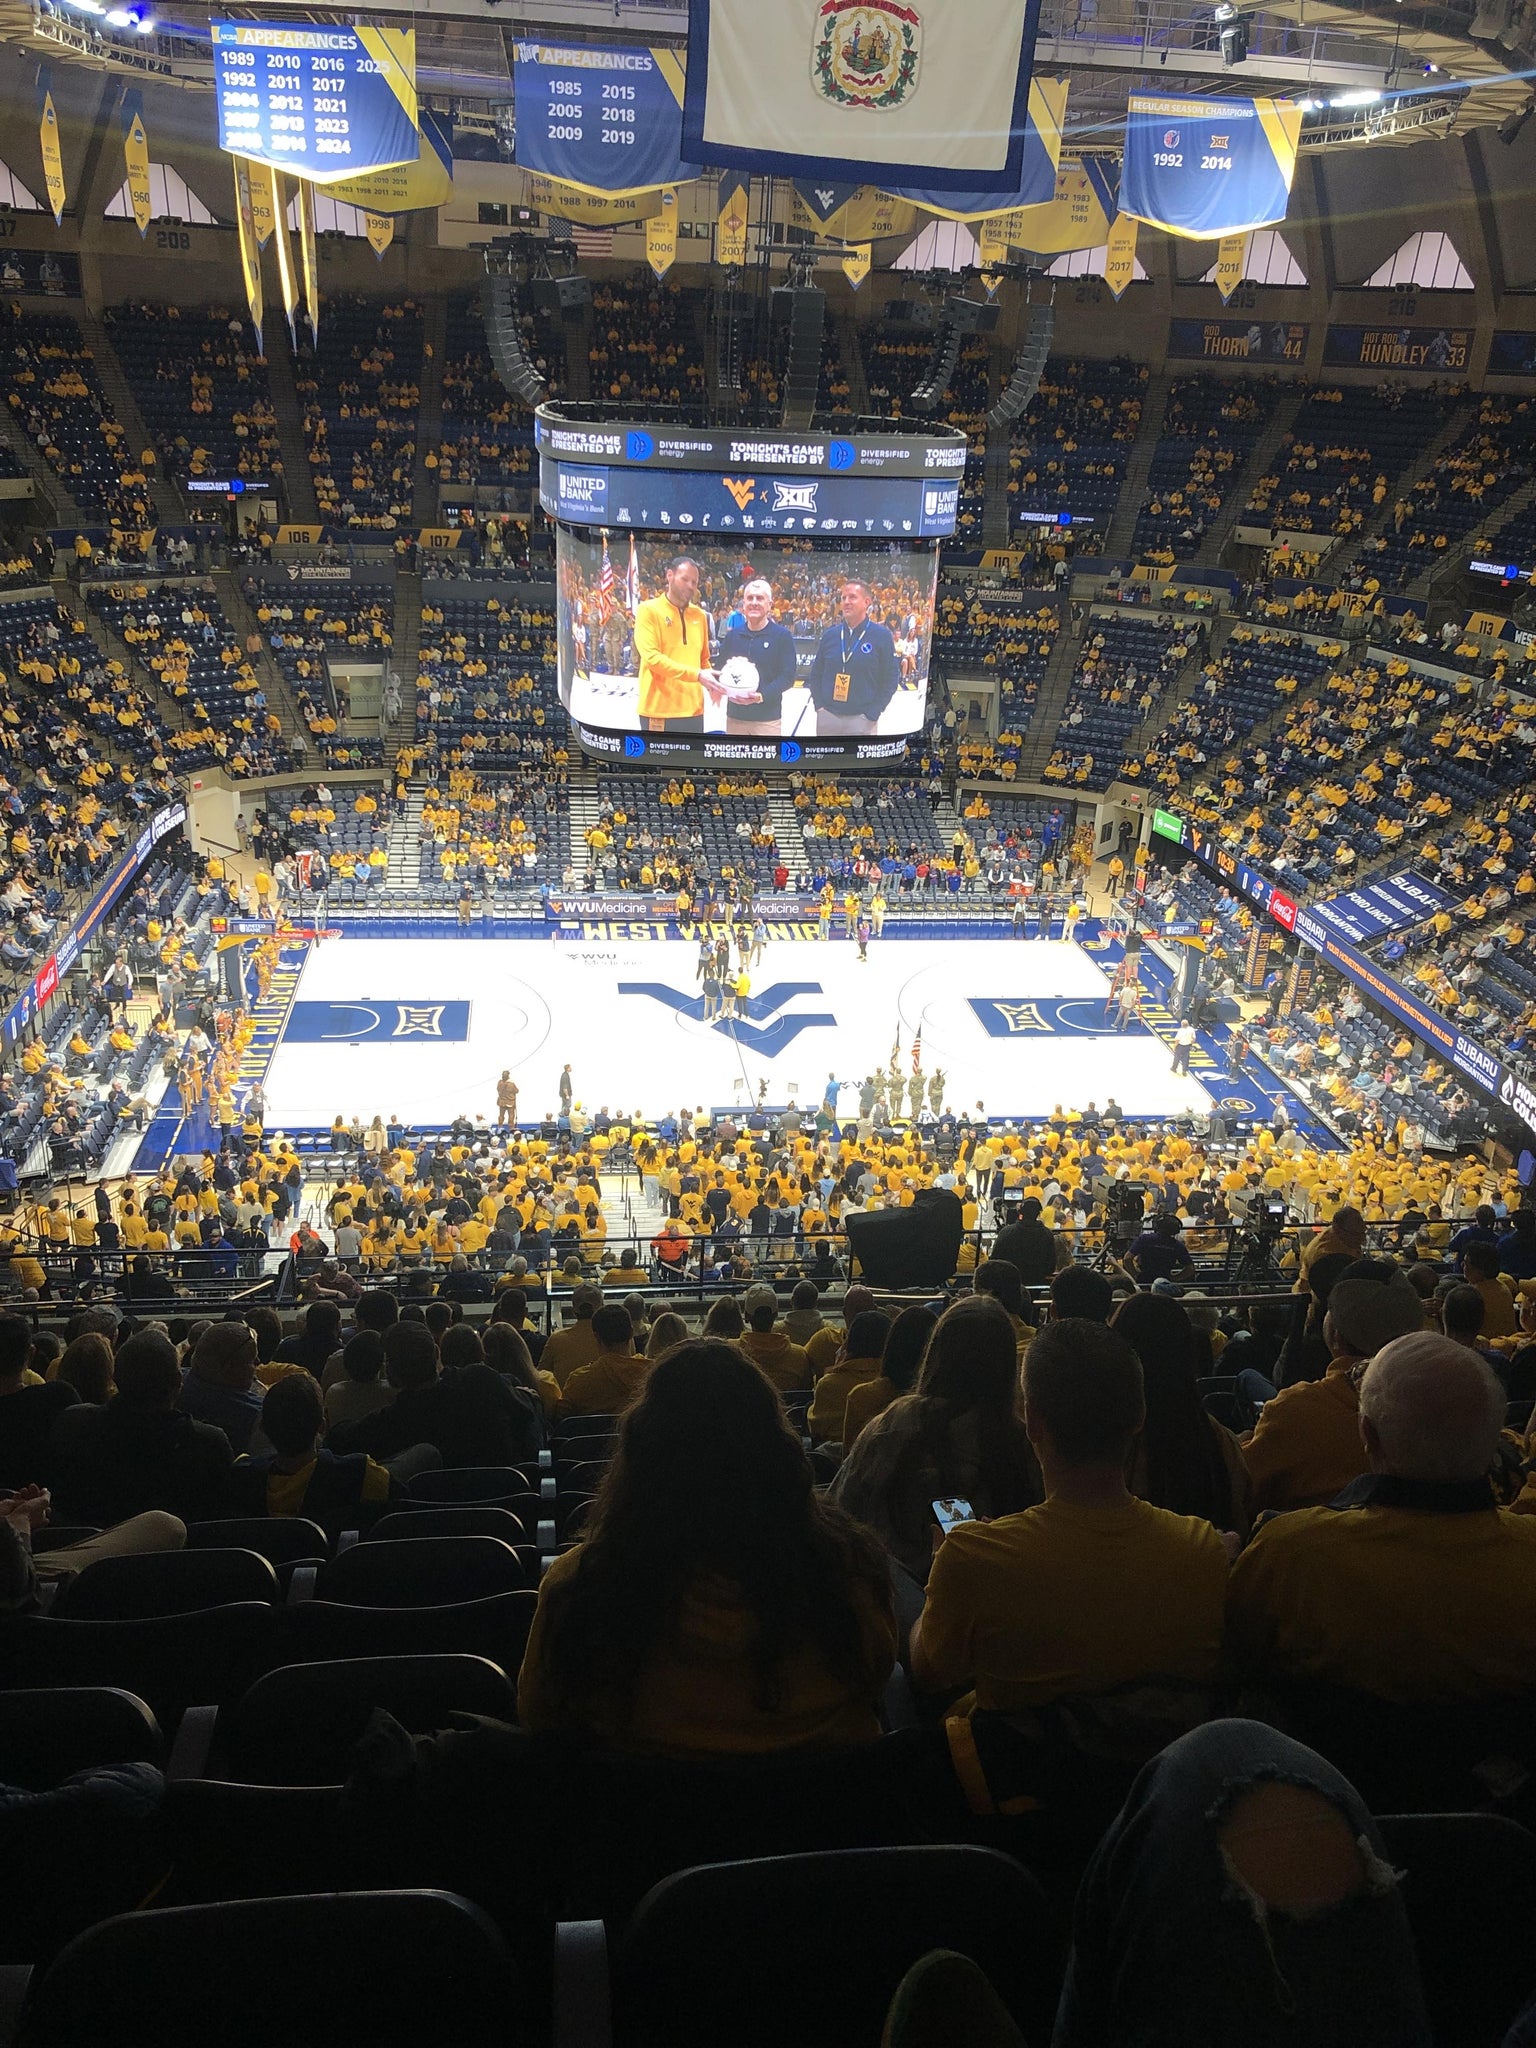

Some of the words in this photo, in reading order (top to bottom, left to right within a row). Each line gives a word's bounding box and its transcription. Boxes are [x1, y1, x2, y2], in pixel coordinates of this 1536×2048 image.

[243, 29, 358, 50] APPEARANCES
[221, 51, 255, 67] 1989
[266, 54, 301, 70] 2010
[311, 57, 345, 72] 2016
[356, 60, 390, 74] 2025
[543, 49, 653, 71] APPEARANCES
[222, 72, 256, 87] 1992
[268, 75, 300, 90] 2011
[312, 78, 345, 93] 2017
[549, 81, 582, 96] 1985
[602, 85, 635, 100] 2015
[269, 95, 304, 111] 2012
[313, 98, 347, 113] 2021
[548, 103, 582, 119] 2005
[602, 107, 635, 122] 2018
[1133, 101, 1170, 112] REGULAR
[1171, 103, 1204, 115] SEASON
[1205, 106, 1254, 118] CHAMPIONS
[315, 118, 349, 134] 2023
[548, 125, 582, 140] 2009
[601, 130, 635, 145] 2019
[316, 138, 351, 154] 2024
[1153, 153, 1183, 168] 1992
[1200, 155, 1232, 170] 2014
[613, 199, 636, 209] 2014
[367, 218, 391, 229] 1998
[872, 222, 893, 232] 2010
[1071, 215, 1088, 223] 1989
[157, 231, 190, 249] 208
[649, 242, 673, 252] 2006
[721, 246, 745, 256] 2007
[1109, 262, 1131, 272] 2017
[1204, 325, 1220, 335] ROD
[1363, 332, 1379, 343] HOT
[1381, 333, 1399, 344] ROD
[1203, 336, 1250, 356] THORN
[1283, 340, 1303, 359] 44
[1360, 344, 1430, 364] HUNDLEY
[1446, 346, 1466, 366] 33
[555, 440, 604, 453] PRESENTED
[606, 445, 621, 455] BY
[588, 434, 621, 445] GAME
[659, 440, 713, 452] DIVERSIFIED
[659, 449, 685, 459] energy
[731, 442, 789, 454] TONIGHT'S
[791, 445, 824, 456] GAME
[861, 449, 910, 459] DIVERSIFIED
[730, 452, 740, 462] IS
[742, 453, 807, 464] PRESENTED
[809, 454, 825, 465] BY
[860, 457, 885, 466] energy
[925, 458, 934, 467] IS
[567, 475, 606, 491] UNITED
[567, 487, 593, 501] BANK
[288, 531, 310, 544] 106
[430, 535, 450, 547] 107
[1147, 568, 1159, 580] 111
[1479, 620, 1494, 635] 113
[1515, 630, 1536, 647] WES
[598, 736, 621, 746] GAME
[610, 743, 621, 752] BY
[650, 743, 691, 751] DIVERSIFIED
[705, 744, 750, 752] TONIGHT'S
[858, 742, 895, 751] TONIGHT'S
[154, 808, 171, 828] HOPE
[155, 809, 186, 839] COLISEUM
[1204, 843, 1211, 860] 0
[1217, 851, 1236, 874] 10:38
[1242, 872, 1249, 890] 0
[1346, 892, 1371, 909] FORD
[1273, 898, 1294, 923] Coca-Cola
[1297, 911, 1326, 942] SUBARU
[1313, 903, 1365, 941] MORGANTOWN
[583, 922, 669, 941] WEST
[1258, 932, 1271, 952] WEST
[1243, 927, 1259, 986] MOUNTAINEERS
[1251, 952, 1268, 986] VIRGINIA
[1299, 968, 1312, 988] WEST
[1326, 941, 1340, 957] YOUR
[1339, 950, 1367, 979] HOMETOWN
[1366, 971, 1386, 995] DEALER
[1385, 986, 1400, 1006] WITH
[1400, 996, 1431, 1031] HOMETOWN
[1431, 1021, 1453, 1048] VALUES
[1456, 1037, 1498, 1077] SUBARU
[1453, 1053, 1494, 1091] MORGANTOWN
[1515, 1081, 1536, 1112] HOP
